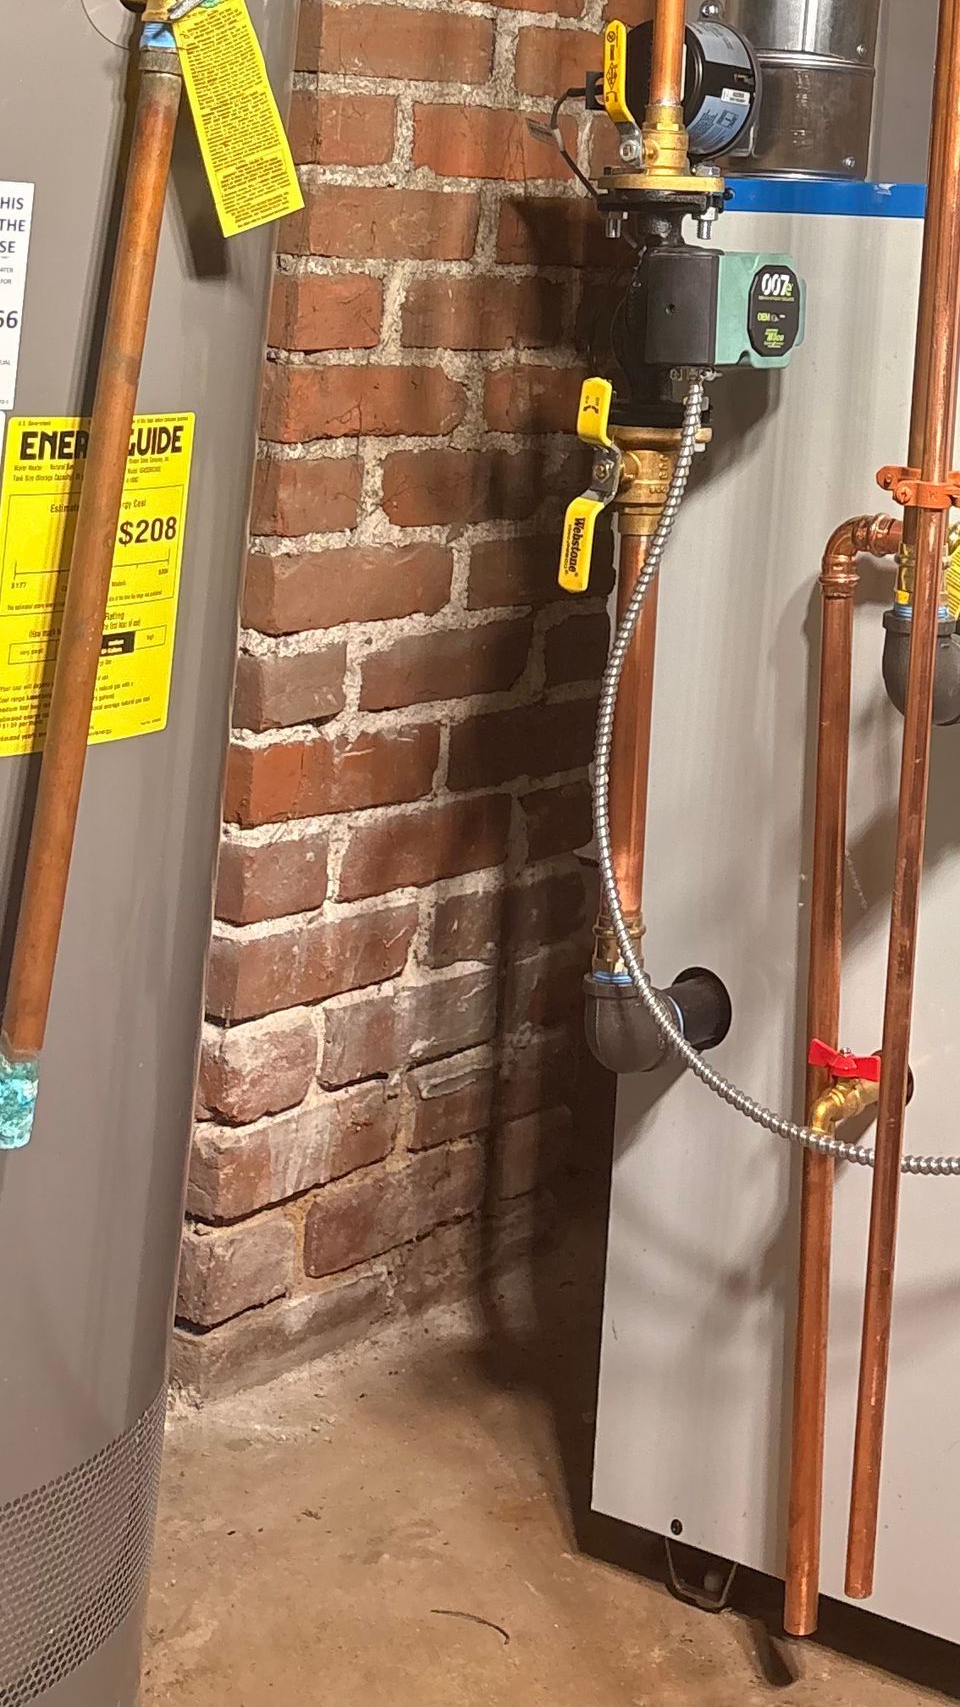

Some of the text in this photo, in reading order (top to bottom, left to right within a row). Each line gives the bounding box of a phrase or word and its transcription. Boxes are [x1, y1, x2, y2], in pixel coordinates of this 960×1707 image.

[0, 218, 26, 232] THE
[118, 516, 177, 547] $208
[568, 517, 586, 573] Webstone
